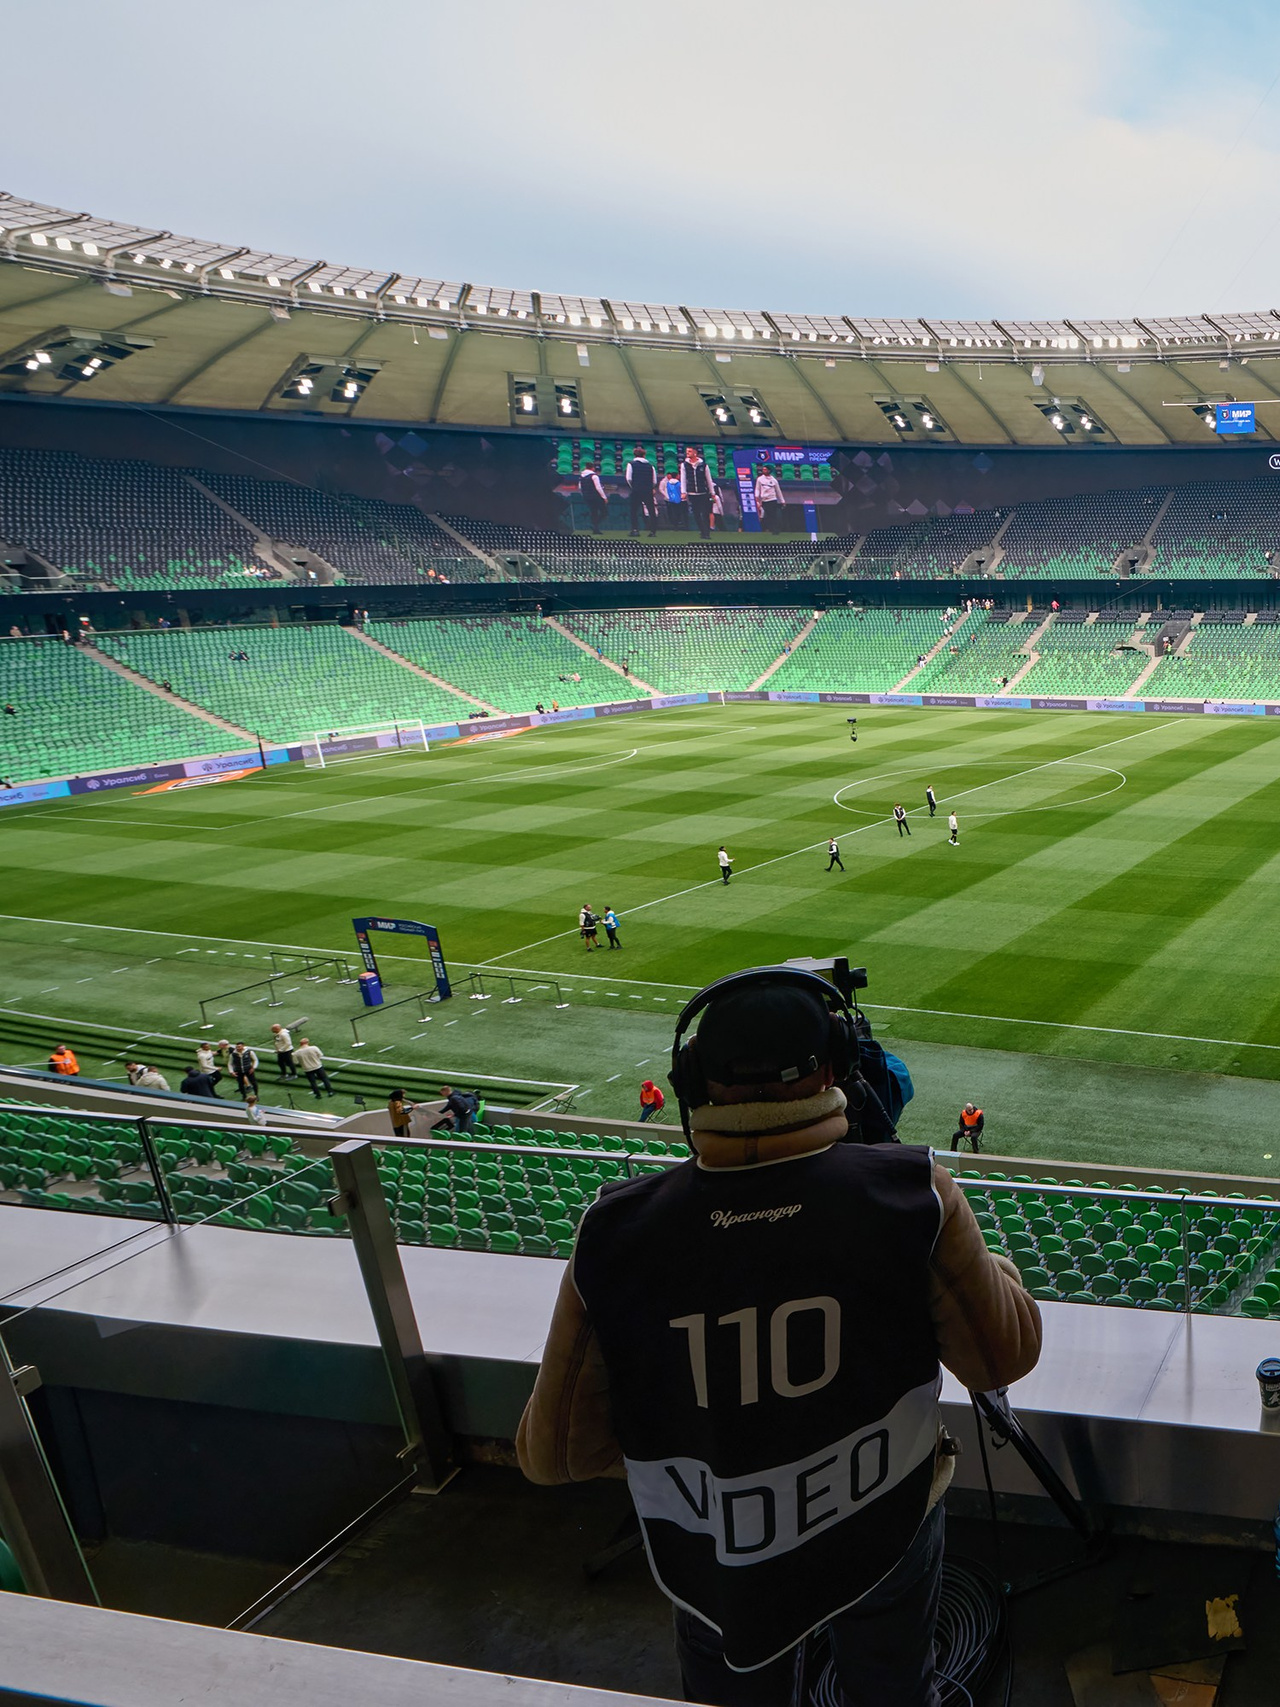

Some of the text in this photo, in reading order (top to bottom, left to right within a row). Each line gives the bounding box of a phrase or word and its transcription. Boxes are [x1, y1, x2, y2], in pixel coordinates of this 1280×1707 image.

[1231, 409, 1252, 418] МИР
[774, 452, 805, 461] МИР
[215, 757, 254, 770] Уралсиб
[102, 773, 147, 787] Уралсиб
[710, 1204, 802, 1229] Краснодар
[669, 1296, 841, 1409] 110
[664, 1428, 890, 1554] VDEO
